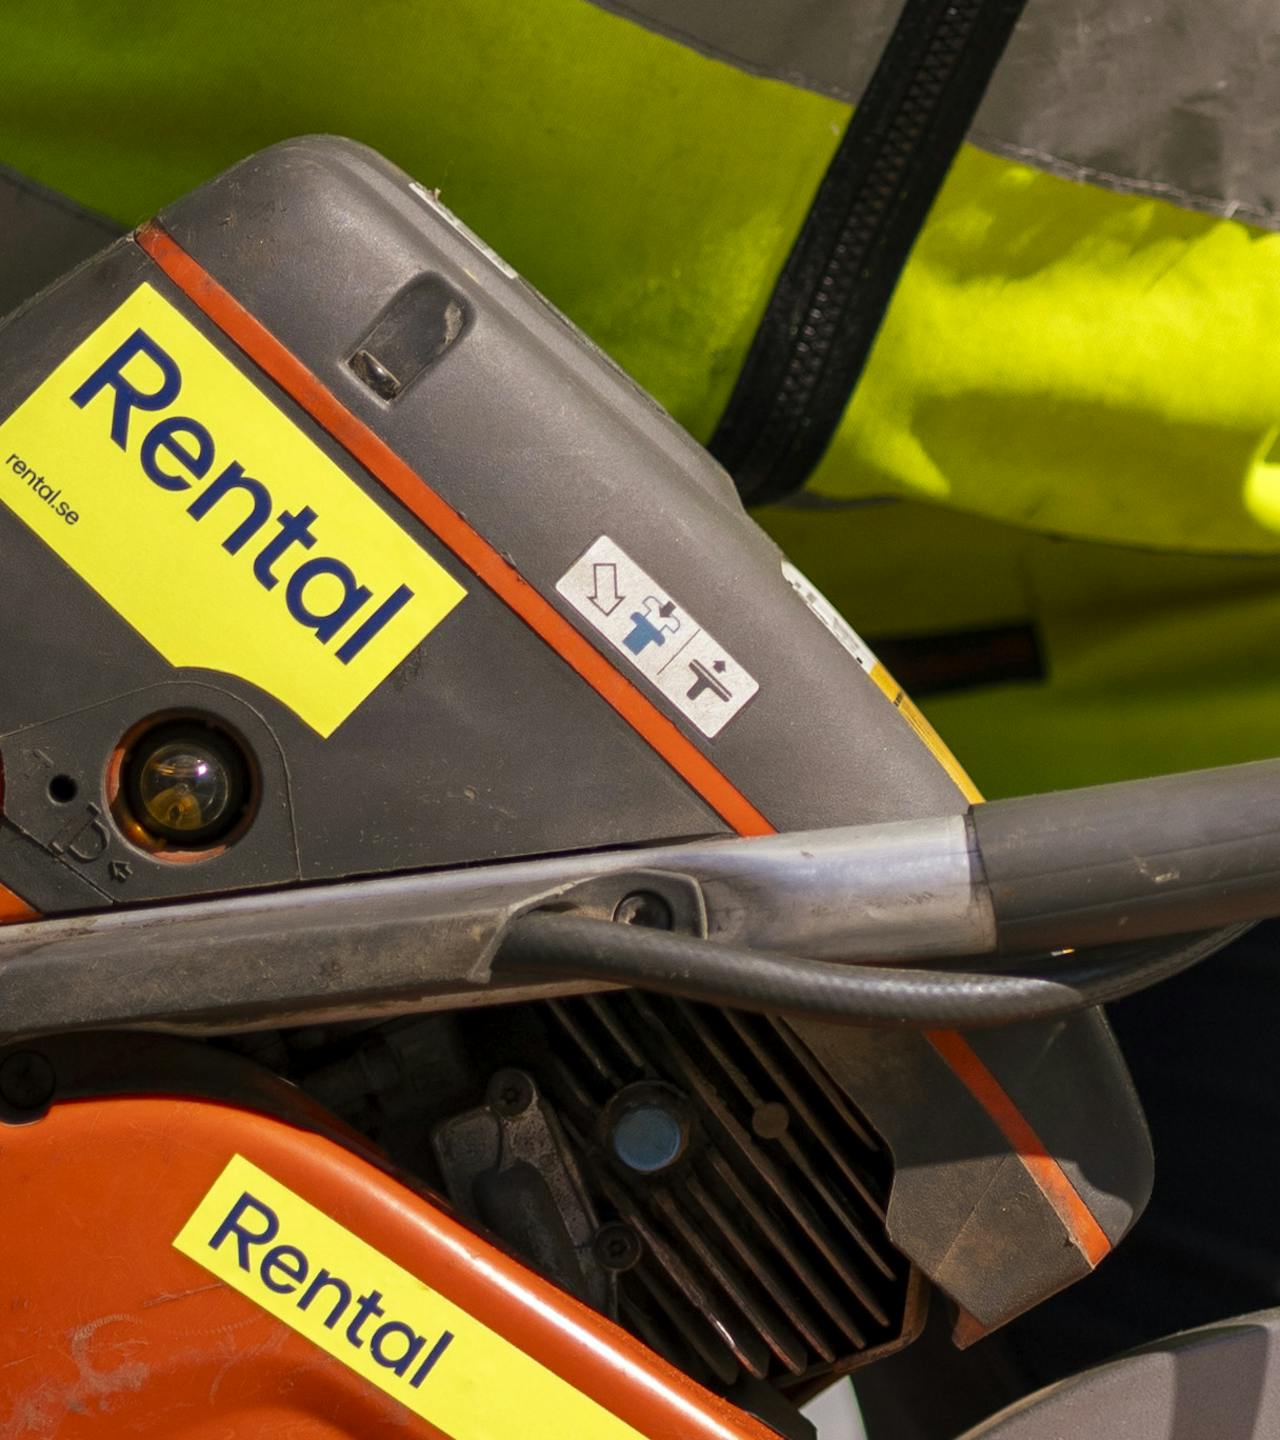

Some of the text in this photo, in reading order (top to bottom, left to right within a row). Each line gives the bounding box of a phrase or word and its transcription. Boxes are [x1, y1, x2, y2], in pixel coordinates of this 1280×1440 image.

[6, 452, 81, 527] rental.se
[70, 327, 415, 665] Rental
[208, 1192, 454, 1389] Rental
